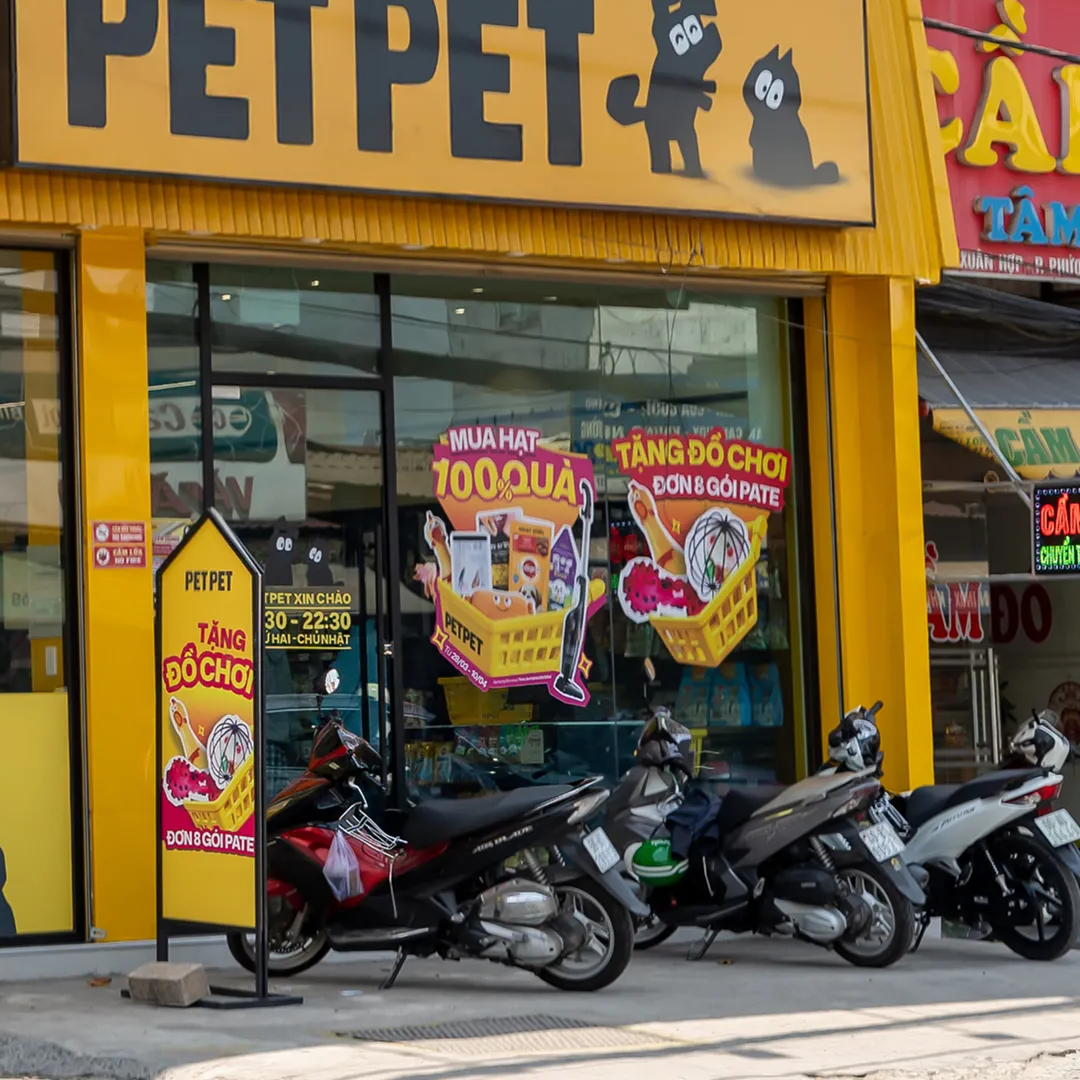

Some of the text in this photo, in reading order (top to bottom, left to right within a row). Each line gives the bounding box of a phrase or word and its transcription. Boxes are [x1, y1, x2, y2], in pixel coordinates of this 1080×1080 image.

[960, 248, 994, 271] XUÂN
[999, 253, 1024, 275] HỢP
[448, 428, 499, 452] MUA
[500, 429, 541, 457] HẠT
[615, 431, 787, 483] TẶNG ĐỒ CHƠI
[433, 457, 577, 505] 100% QUÀ
[652, 473, 780, 508] ĐƠN 8 GÓI PATE
[185, 571, 233, 592] PET PET
[269, 592, 292, 605] PET
[293, 593, 315, 605] XIN
[316, 589, 352, 605] CHÀO
[302, 611, 351, 630] 22:30
[198, 620, 247, 653] TẶNG
[271, 633, 291, 645] HAI
[166, 647, 253, 696] ĐỒ CHƠI
[166, 829, 254, 853] ĐƠN 8 GÓI PATE
